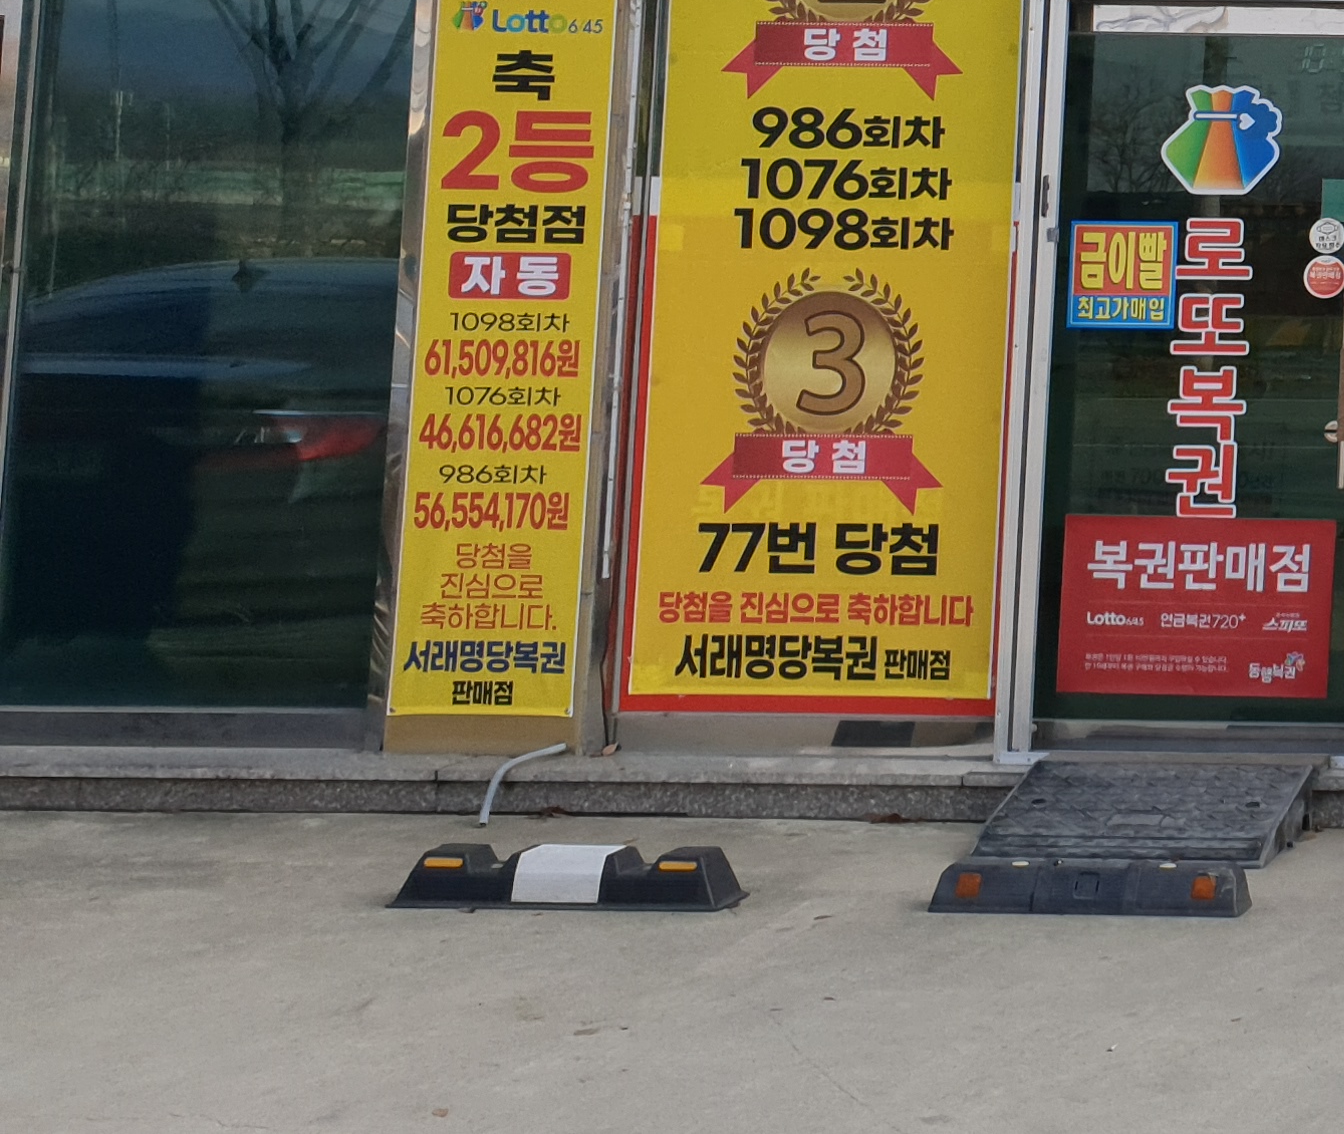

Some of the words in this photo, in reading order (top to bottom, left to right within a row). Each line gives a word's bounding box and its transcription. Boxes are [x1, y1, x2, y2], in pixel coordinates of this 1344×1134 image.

[803, 28, 888, 62] 당첨
[492, 49, 555, 101] 축
[752, 106, 945, 150] 986회차
[441, 110, 594, 194] 2등
[740, 157, 952, 200] 1076회차
[447, 204, 586, 245] 당첨점
[734, 207, 954, 251] 1098회차
[461, 255, 559, 296] 자동
[1080, 232, 1166, 291] 금이빨
[450, 311, 570, 333] 1098회차
[1077, 297, 1165, 321] 최고가매입
[424, 339, 579, 379] 61,509,816원
[1165, 217, 1253, 518] 로또복권
[445, 385, 561, 407] 1076회차
[419, 413, 581, 453] 46,616,682원
[438, 464, 547, 485] 986회차
[782, 440, 867, 474] 당첨
[413, 491, 569, 532] 56,554,170원
[455, 543, 532, 570] 당첨을
[697, 522, 817, 574] 77번
[835, 522, 940, 576] 당첨
[1087, 539, 1311, 593] 복권판매점
[440, 573, 543, 600] 진심으로
[658, 591, 733, 623] 당첨을
[740, 592, 840, 624] 진심으로
[847, 593, 974, 627] 축하합니다
[403, 639, 566, 674] 서래명당복권
[674, 634, 878, 681] 서래명당복권
[883, 648, 951, 681] 판매점
[452, 680, 513, 706] 판매점
